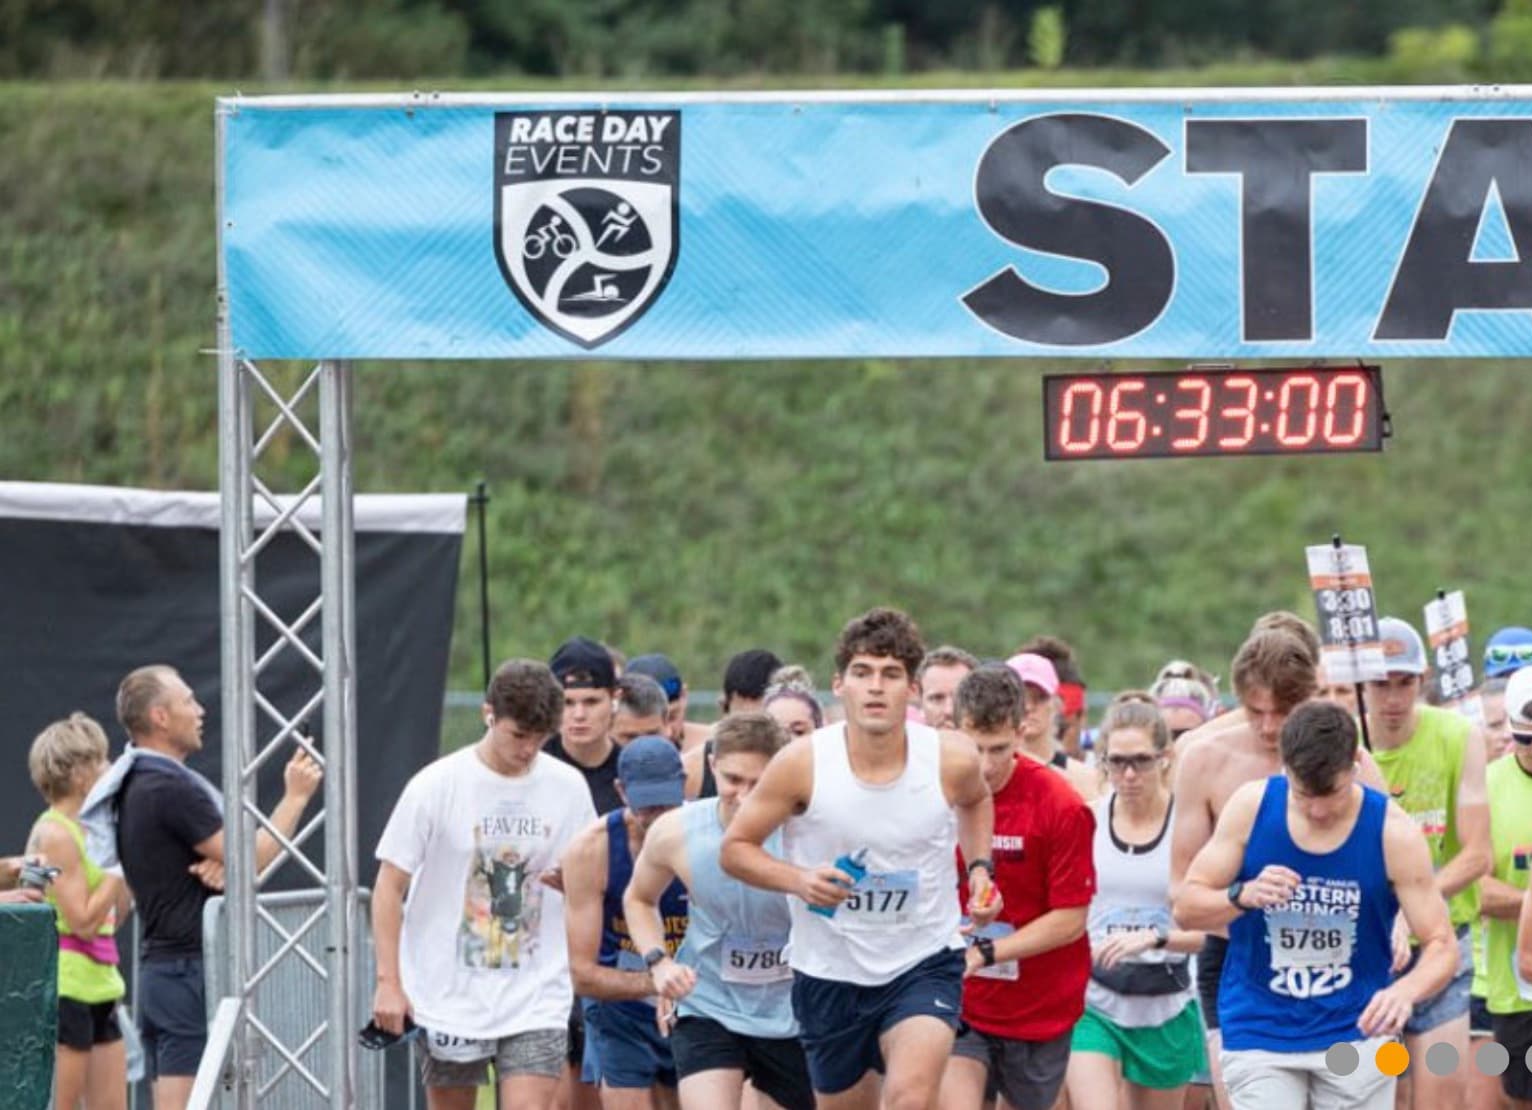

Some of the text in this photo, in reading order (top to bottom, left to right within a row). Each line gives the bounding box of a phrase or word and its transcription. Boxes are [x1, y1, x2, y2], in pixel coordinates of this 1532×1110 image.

[510, 116, 672, 143] RACE DAY
[504, 146, 664, 175] EVENTS
[1059, 374, 1367, 452] 06:33:00
[483, 815, 543, 836] FAVRE
[847, 889, 910, 912] 5177
[1290, 884, 1361, 905] STERN
[1279, 927, 1342, 950] 5786
